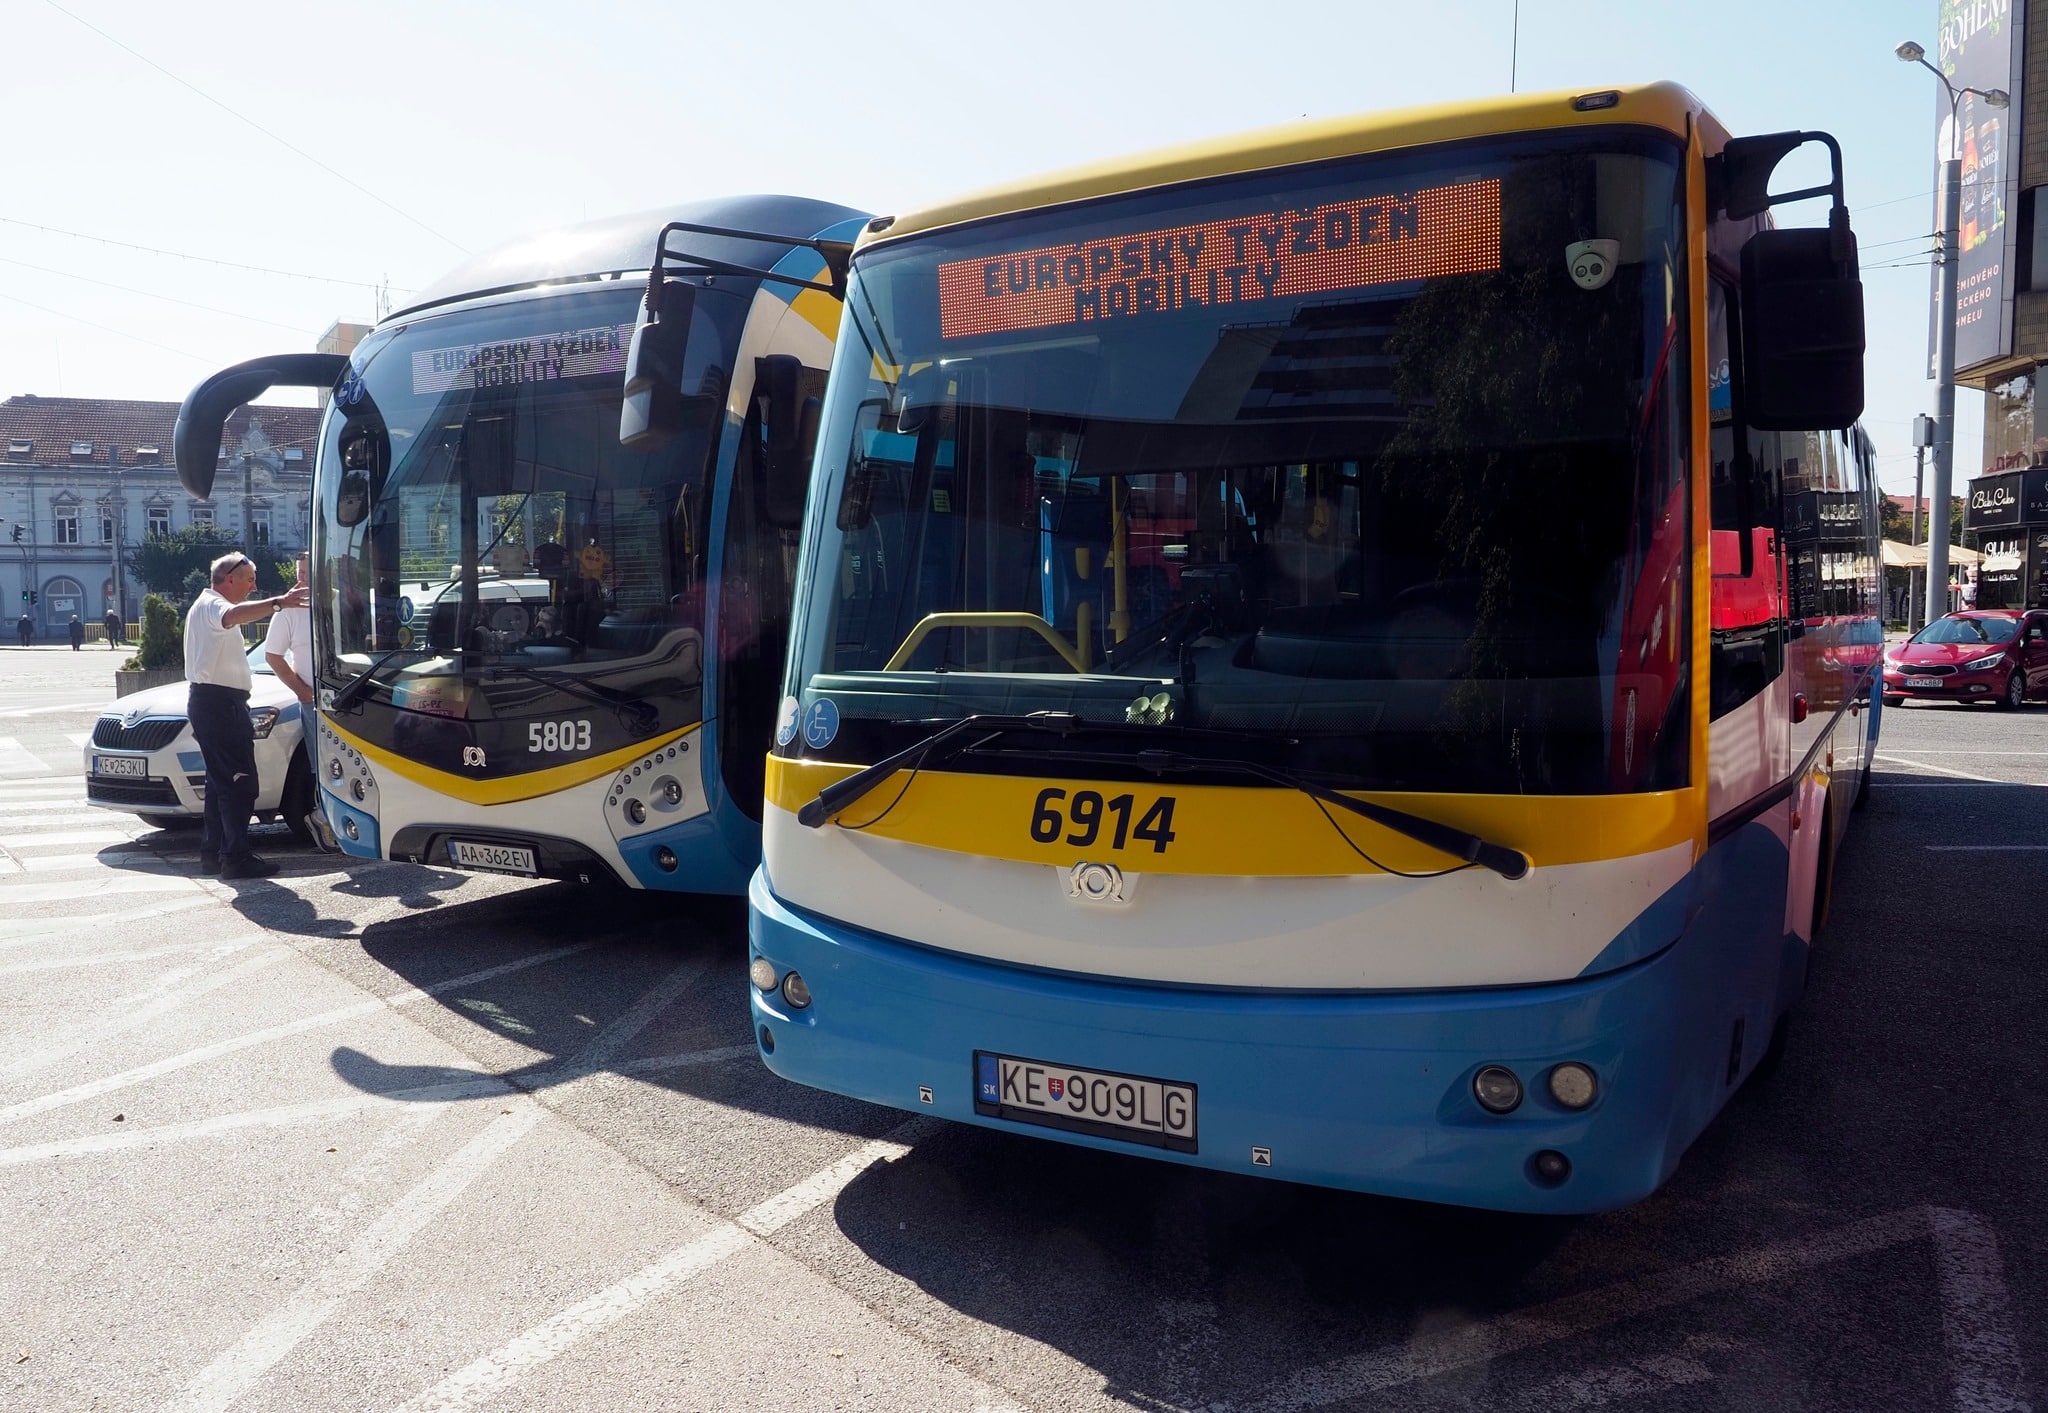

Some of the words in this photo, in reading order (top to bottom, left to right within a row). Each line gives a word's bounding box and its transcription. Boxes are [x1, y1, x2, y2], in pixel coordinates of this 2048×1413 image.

[1075, 261, 1281, 322] MOBILITY
[529, 720, 591, 752] 5803
[1030, 788, 1176, 853] 6914
[983, 1083, 996, 1096] SK
